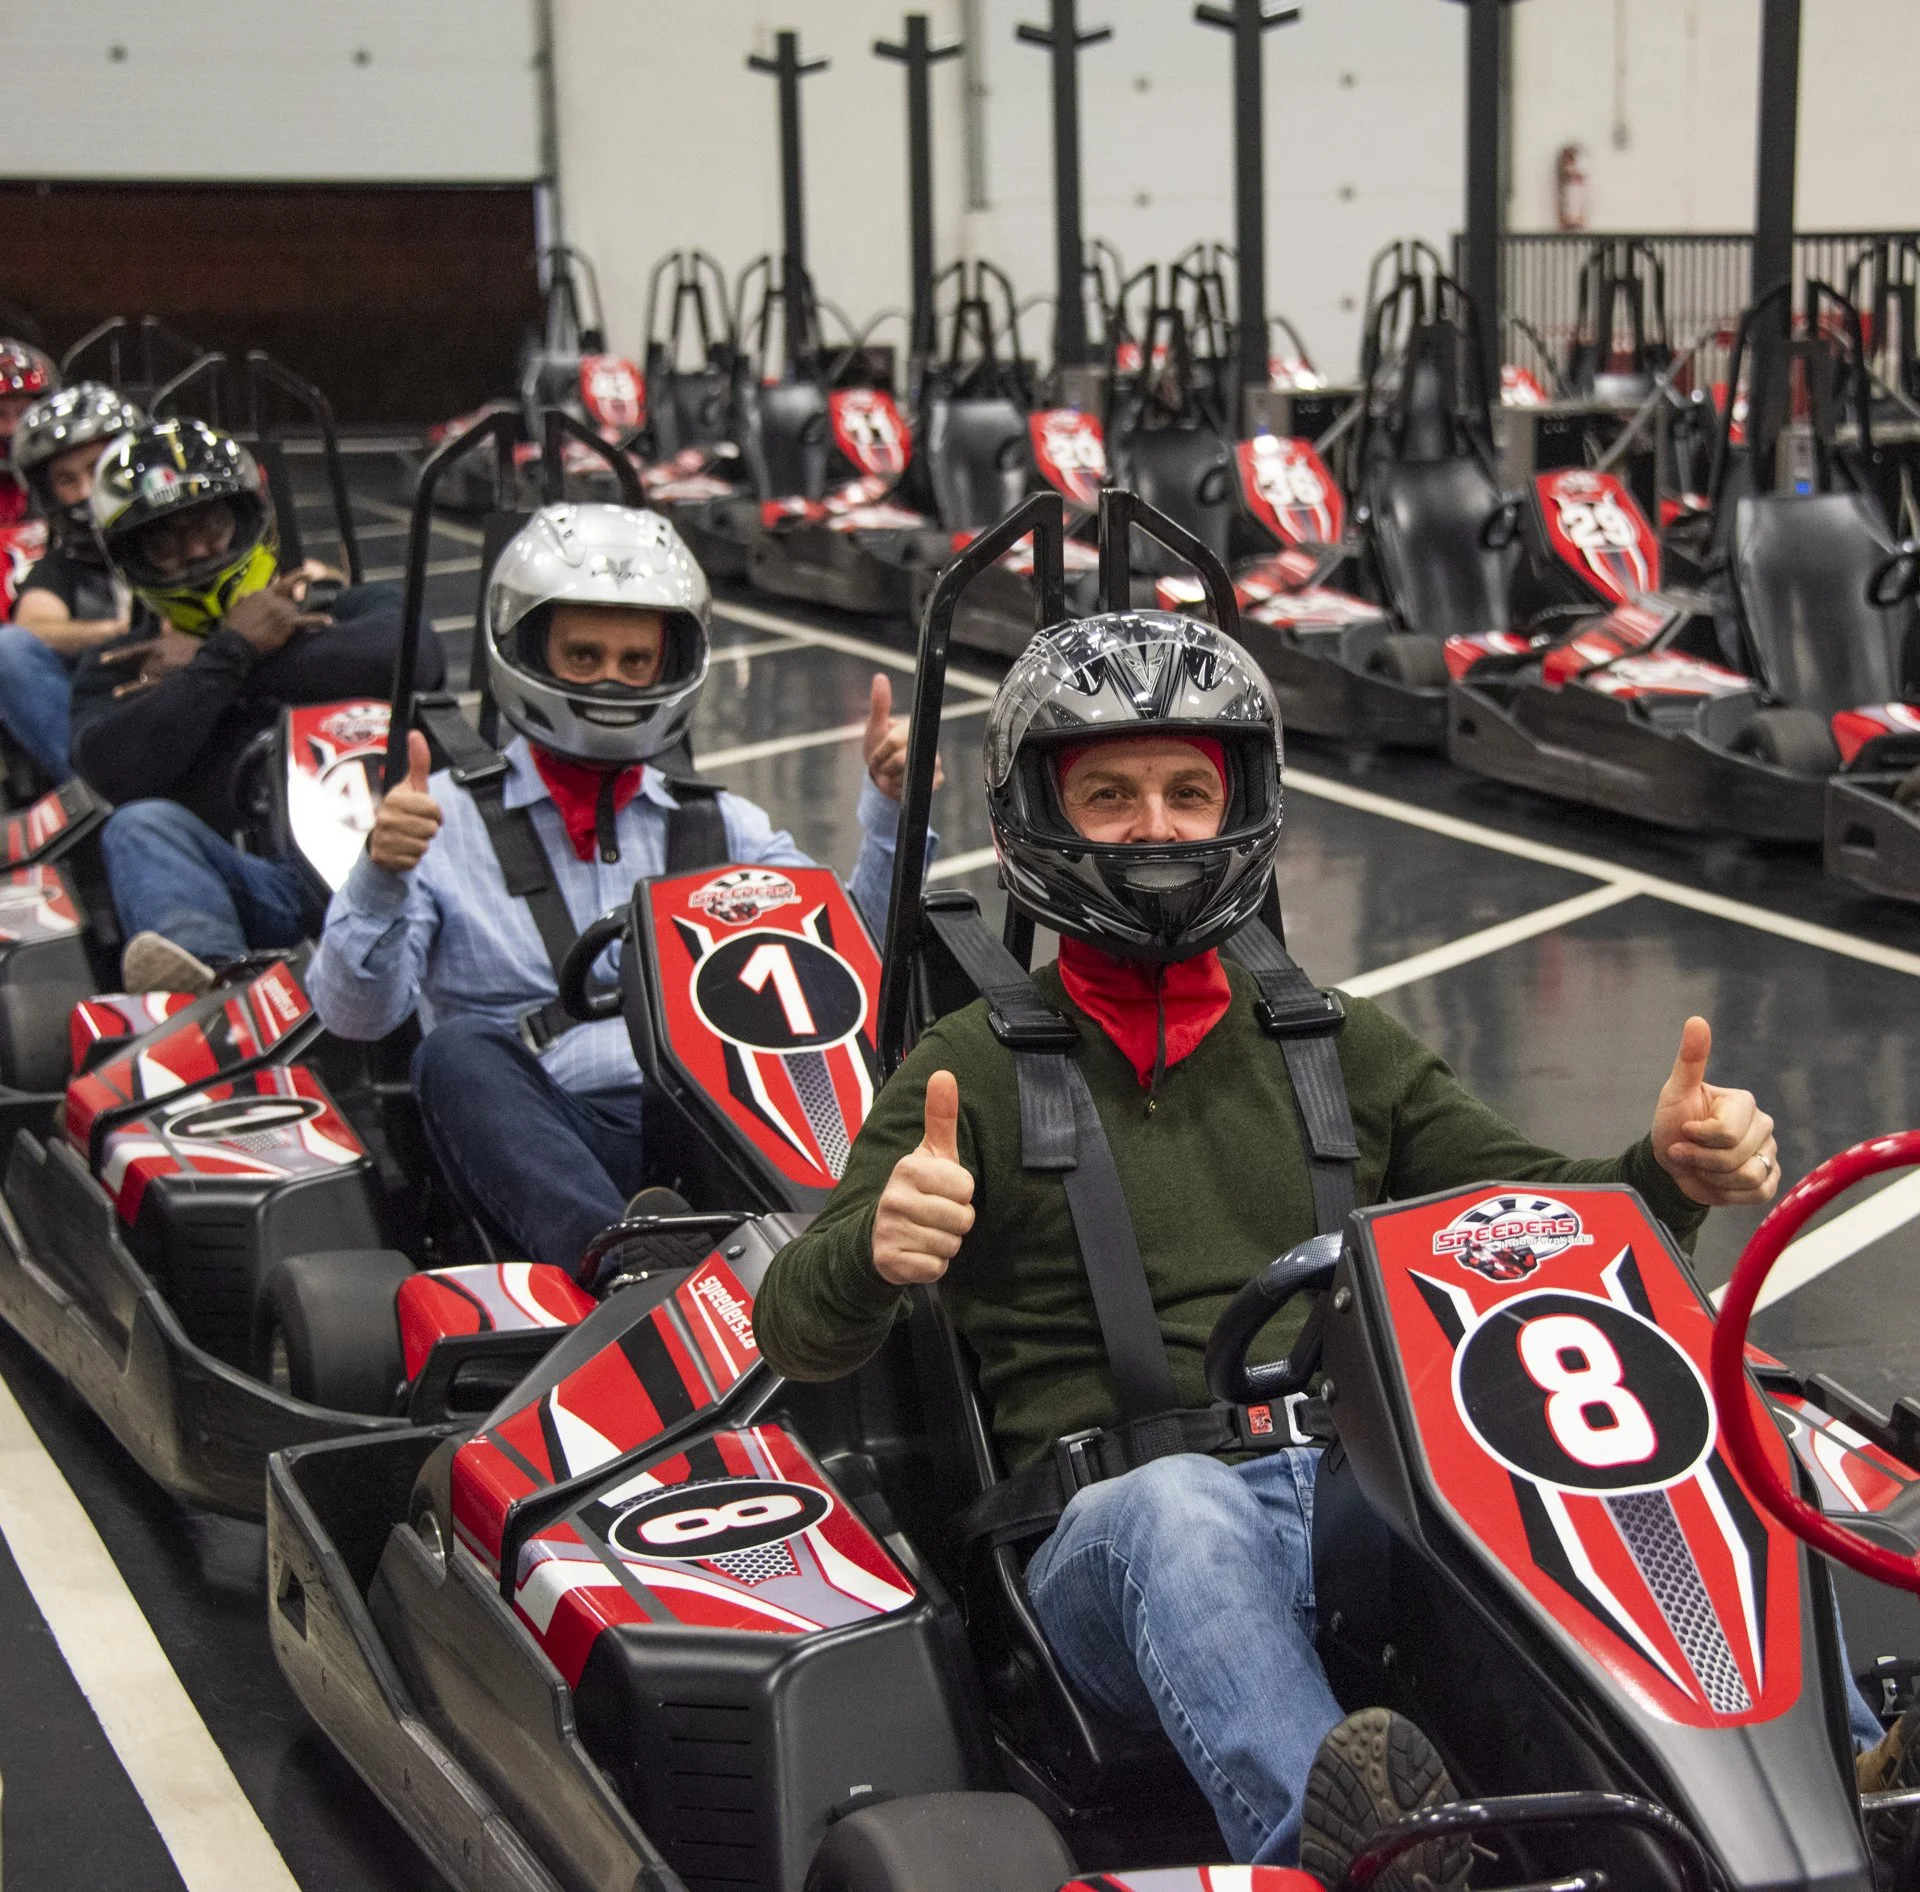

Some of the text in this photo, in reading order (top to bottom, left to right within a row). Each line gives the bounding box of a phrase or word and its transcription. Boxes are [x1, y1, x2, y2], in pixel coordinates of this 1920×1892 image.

[1562, 503, 1633, 548] 29
[738, 943, 818, 1036] 1
[187, 1105, 304, 1134] 1
[1437, 1219, 1576, 1250] SPEEDERS
[1516, 1313, 1658, 1468] 8
[636, 1494, 805, 1545] 8
